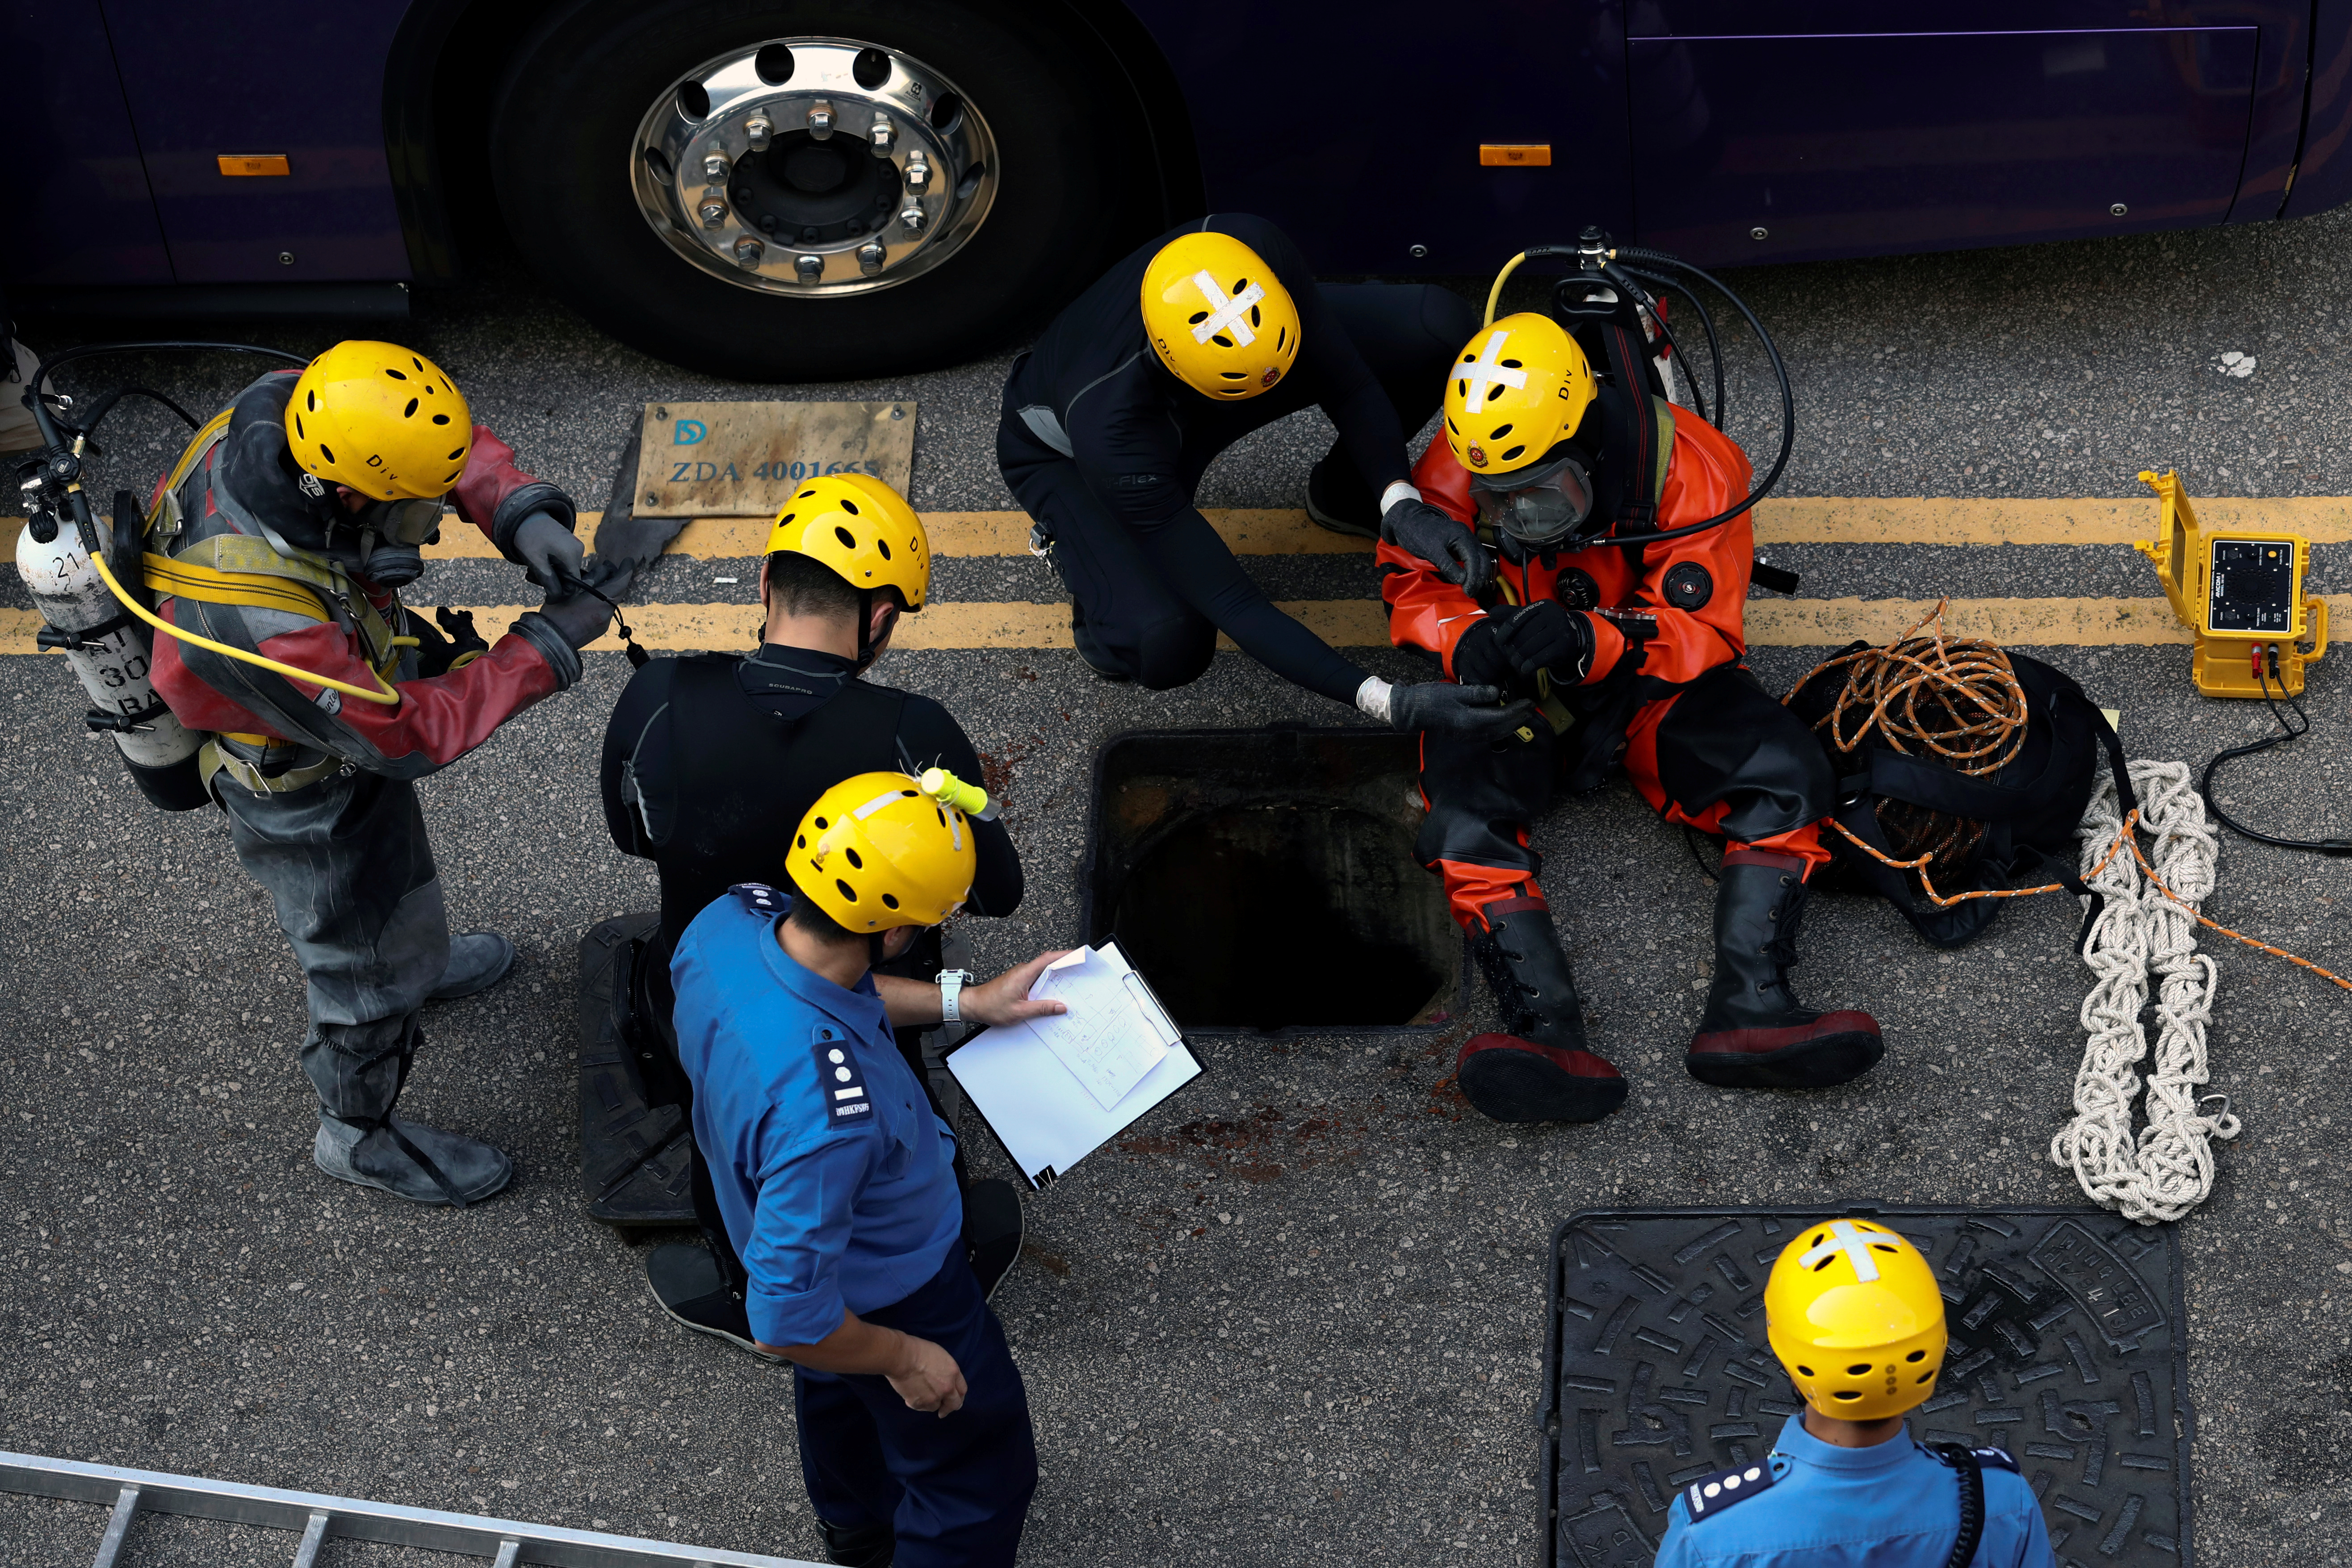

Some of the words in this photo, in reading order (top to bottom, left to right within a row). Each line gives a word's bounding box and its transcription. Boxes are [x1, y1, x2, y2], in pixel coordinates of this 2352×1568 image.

[366, 454, 398, 480] Div
[669, 461, 743, 482] ZDA
[910, 536, 924, 570] Div
[1513, 600, 1545, 621] SCUBAPRO
[768, 683, 813, 695] SCUBAPRO
